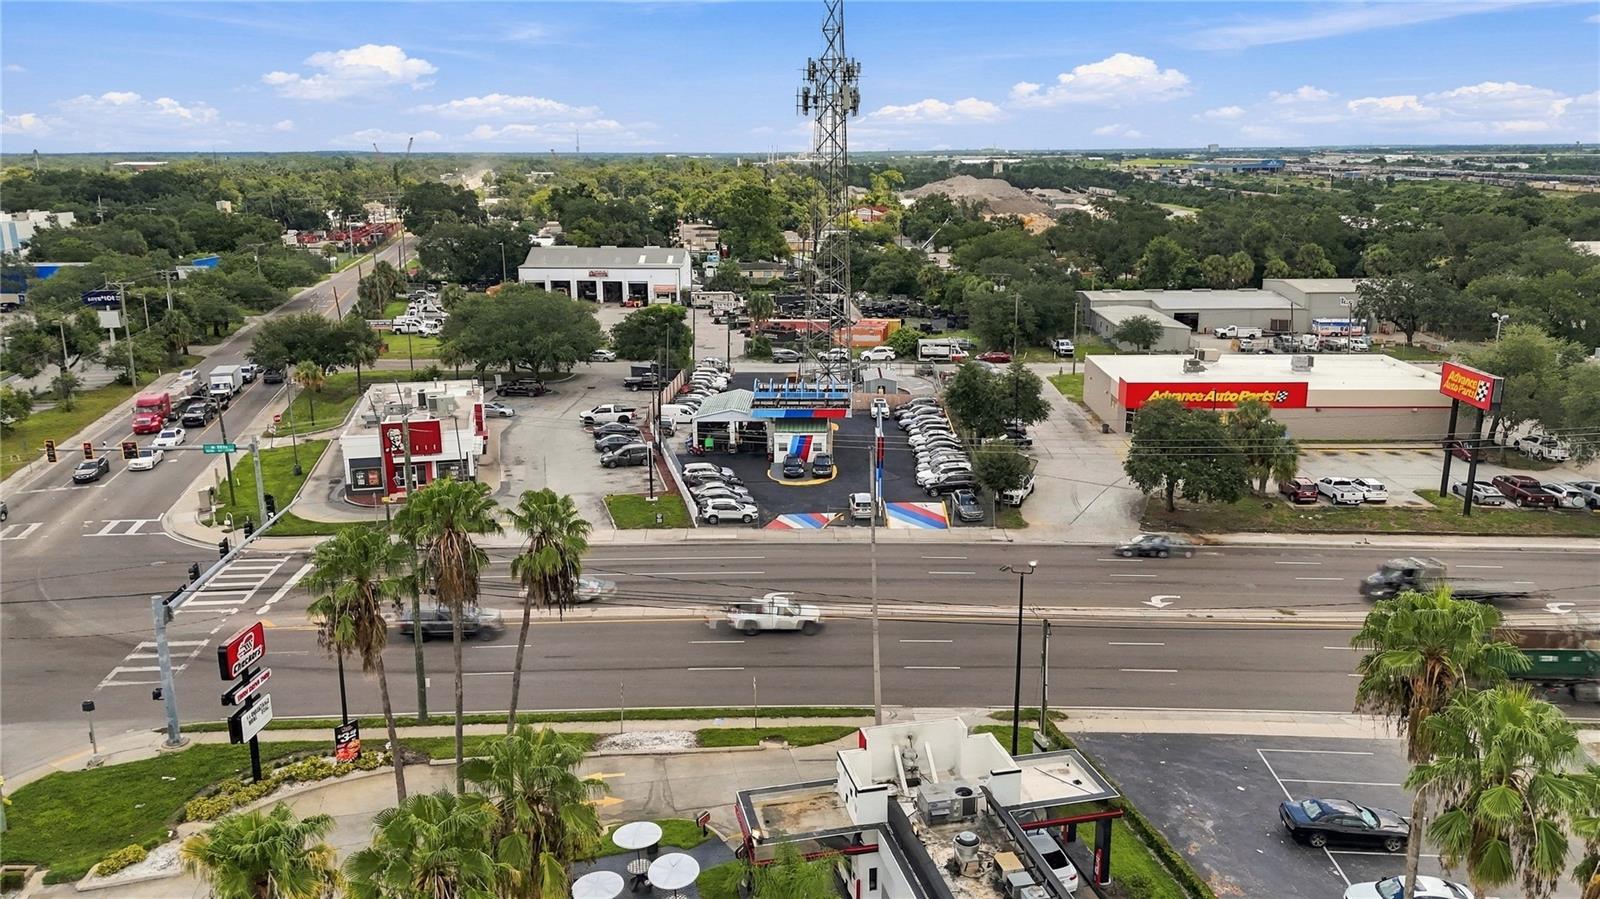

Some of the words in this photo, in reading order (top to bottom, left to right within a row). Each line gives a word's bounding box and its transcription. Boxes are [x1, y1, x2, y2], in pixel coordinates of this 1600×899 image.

[1448, 371, 1478, 389] Advance
[1147, 390, 1203, 402] Advance
[1204, 390, 1238, 402] Auto
[1238, 390, 1275, 402] Parts
[1443, 381, 1458, 393] Auto
[1458, 385, 1475, 399] Parts
[233, 647, 261, 674] Checkers
